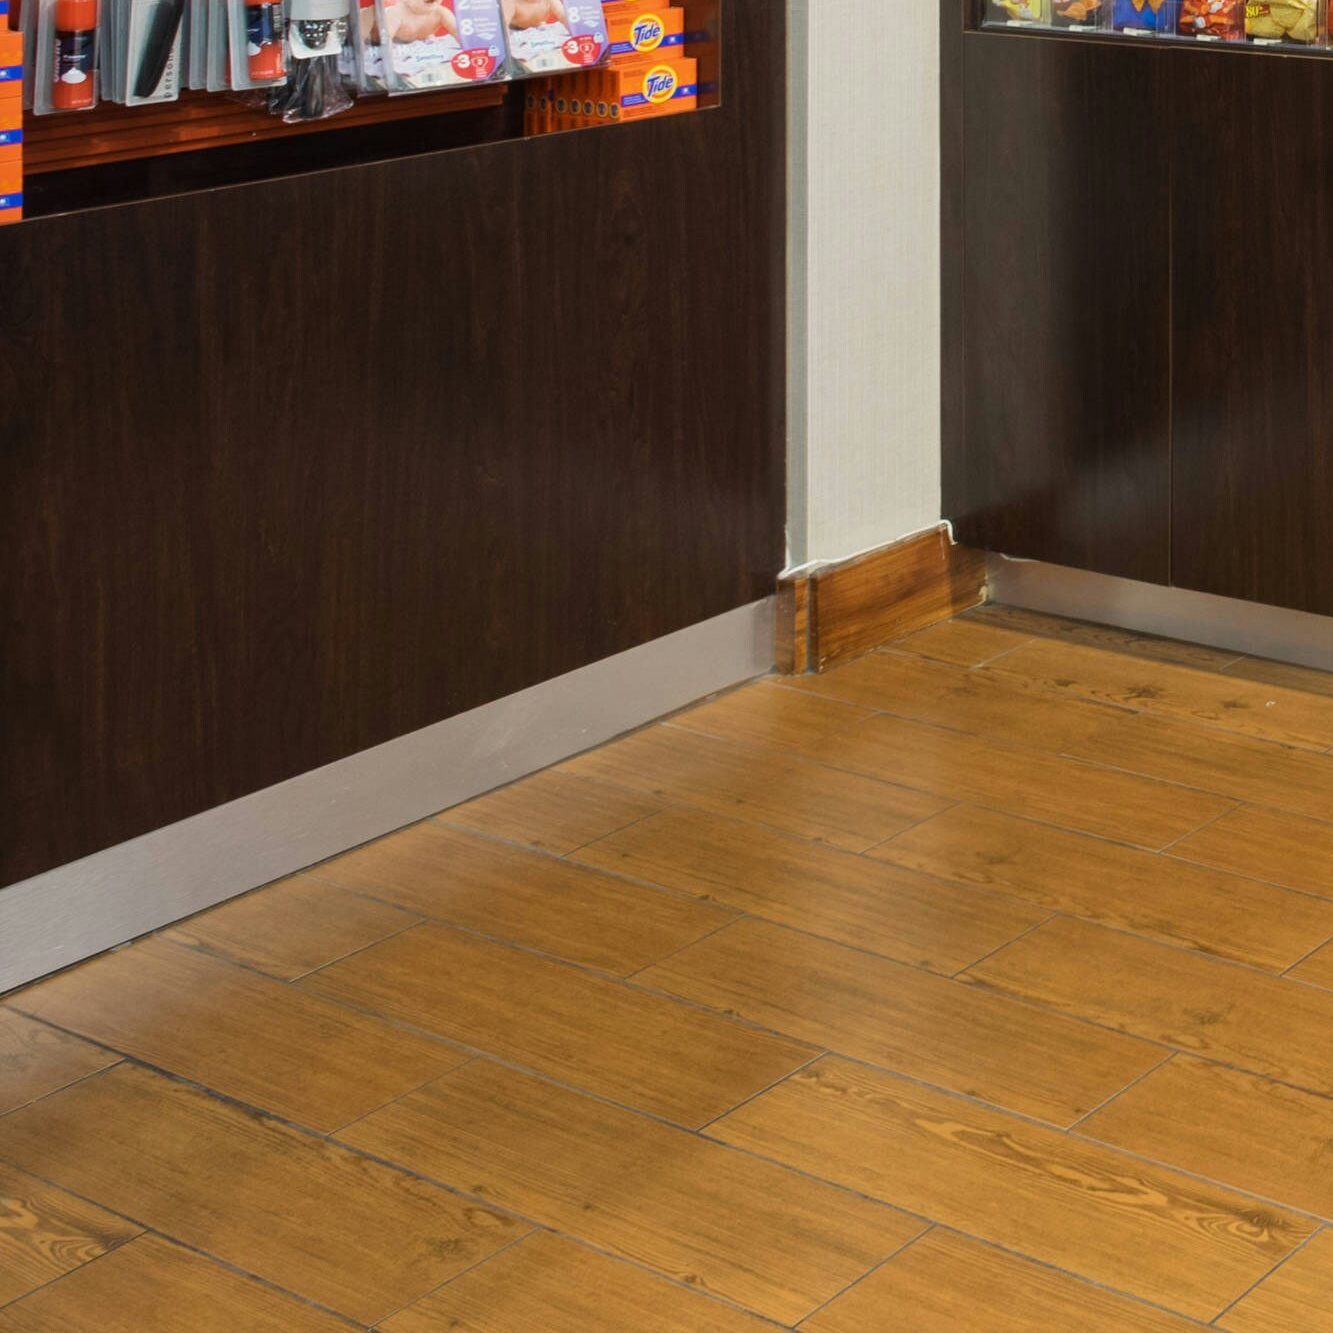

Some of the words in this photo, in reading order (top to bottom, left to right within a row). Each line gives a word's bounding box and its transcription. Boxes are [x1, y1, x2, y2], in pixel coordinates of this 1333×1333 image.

[459, 19, 474, 36] 8
[633, 22, 661, 43] Tide
[646, 75, 674, 95] Tide
